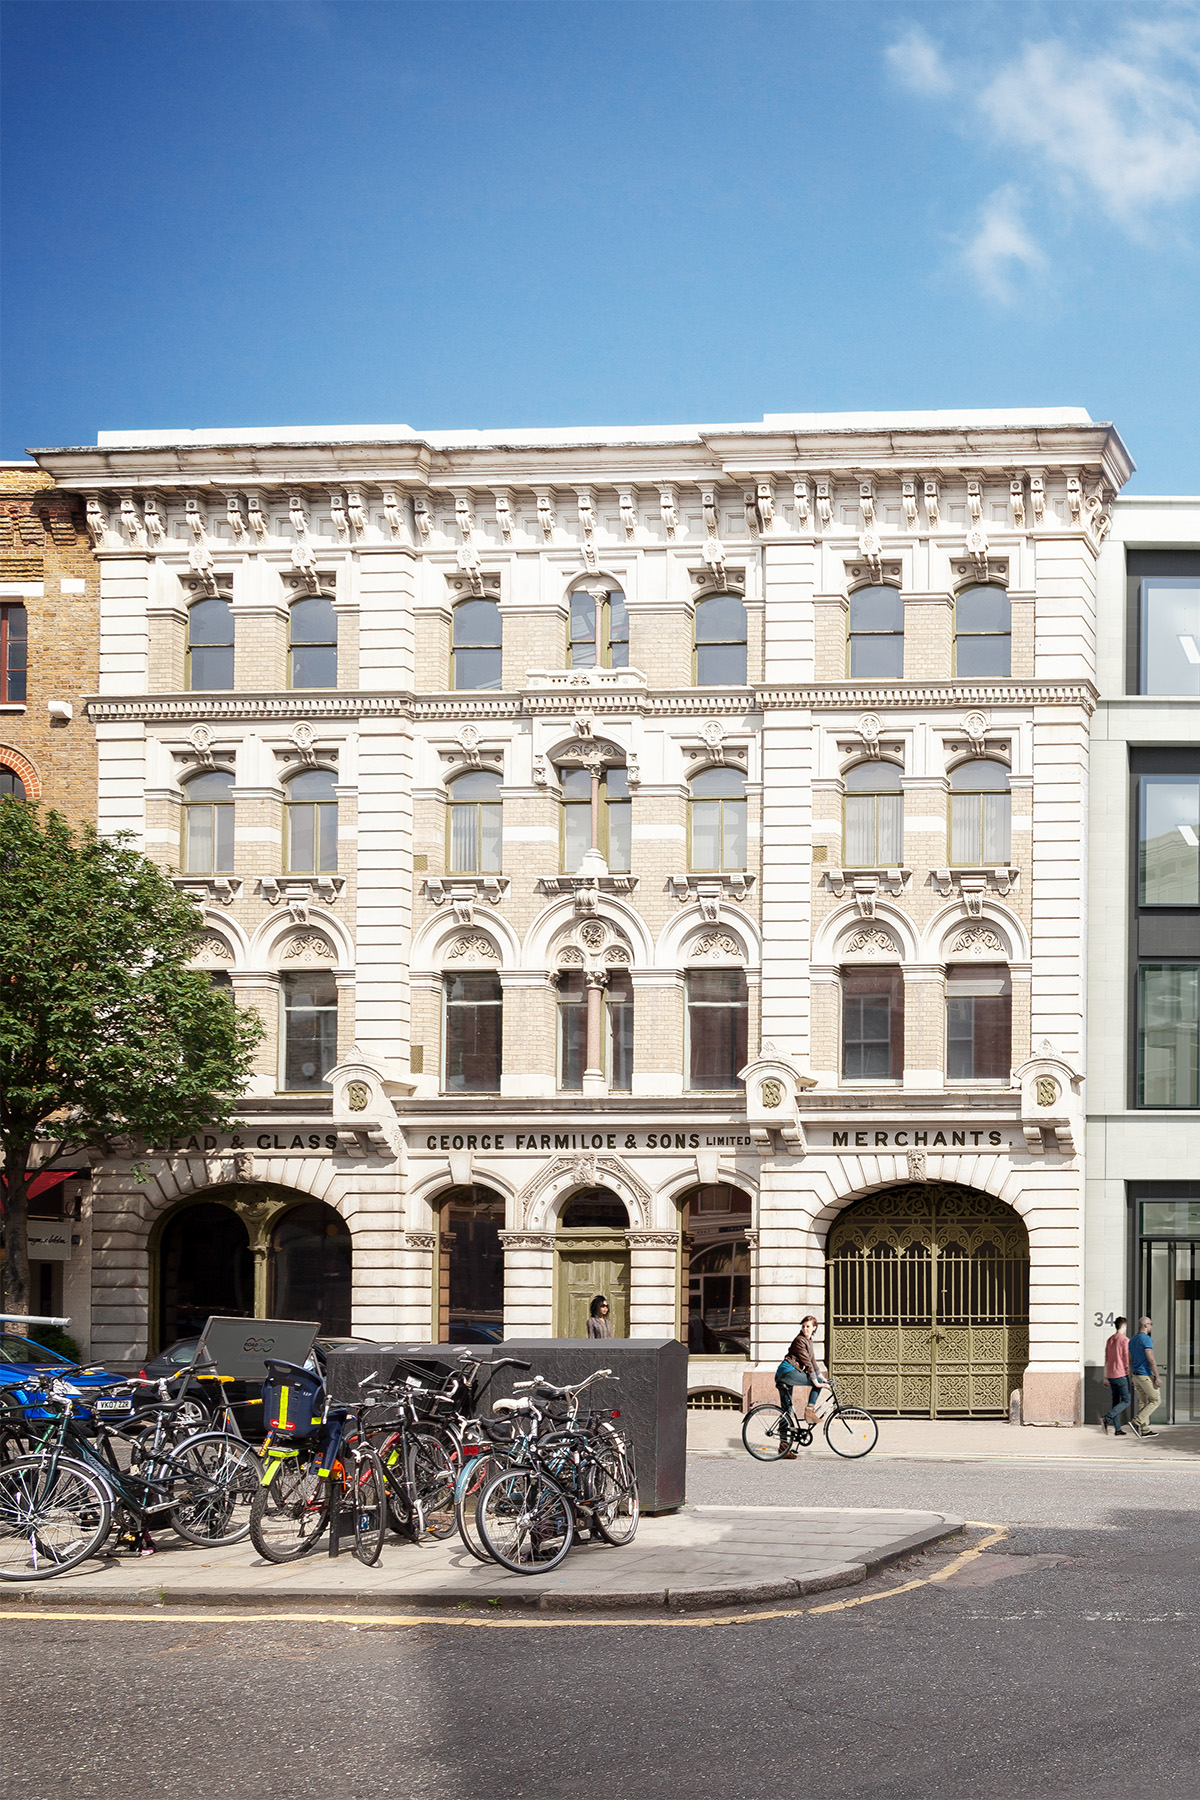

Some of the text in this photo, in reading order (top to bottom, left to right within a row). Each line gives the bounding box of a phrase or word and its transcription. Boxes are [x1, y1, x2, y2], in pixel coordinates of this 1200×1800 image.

[231, 1135, 244, 1150] &
[256, 1134, 338, 1150] GLASS
[427, 1133, 751, 1150] GEORGE FARMILOE & SONS LIMITED
[1094, 1312, 1115, 1327] 34
